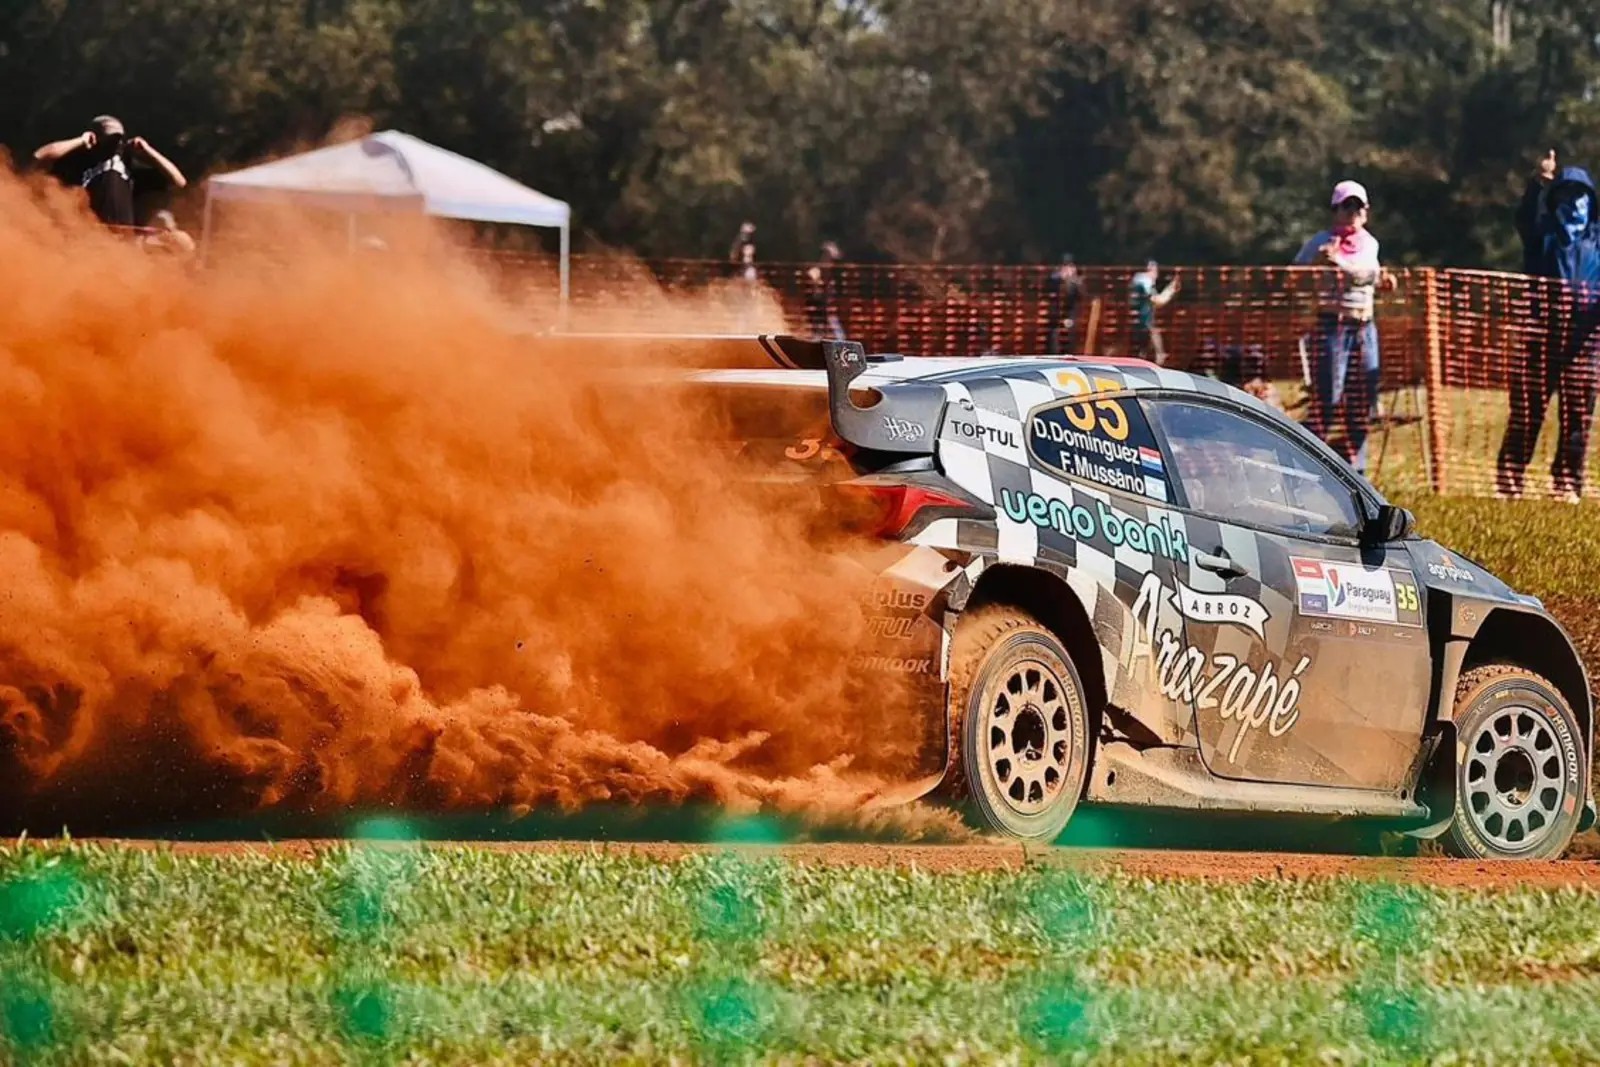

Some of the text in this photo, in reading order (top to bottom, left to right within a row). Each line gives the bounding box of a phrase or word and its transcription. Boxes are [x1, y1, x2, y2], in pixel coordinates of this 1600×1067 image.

[1056, 371, 1129, 441] 35
[950, 419, 1019, 449] TOPTUL
[1001, 488, 1188, 567] ueno bank
[1346, 582, 1391, 605] Paraguay
[1395, 582, 1419, 611] 35
[1191, 599, 1251, 619] ARROZ
[865, 616, 914, 640] TUL
[1130, 570, 1311, 764] Arazapé
